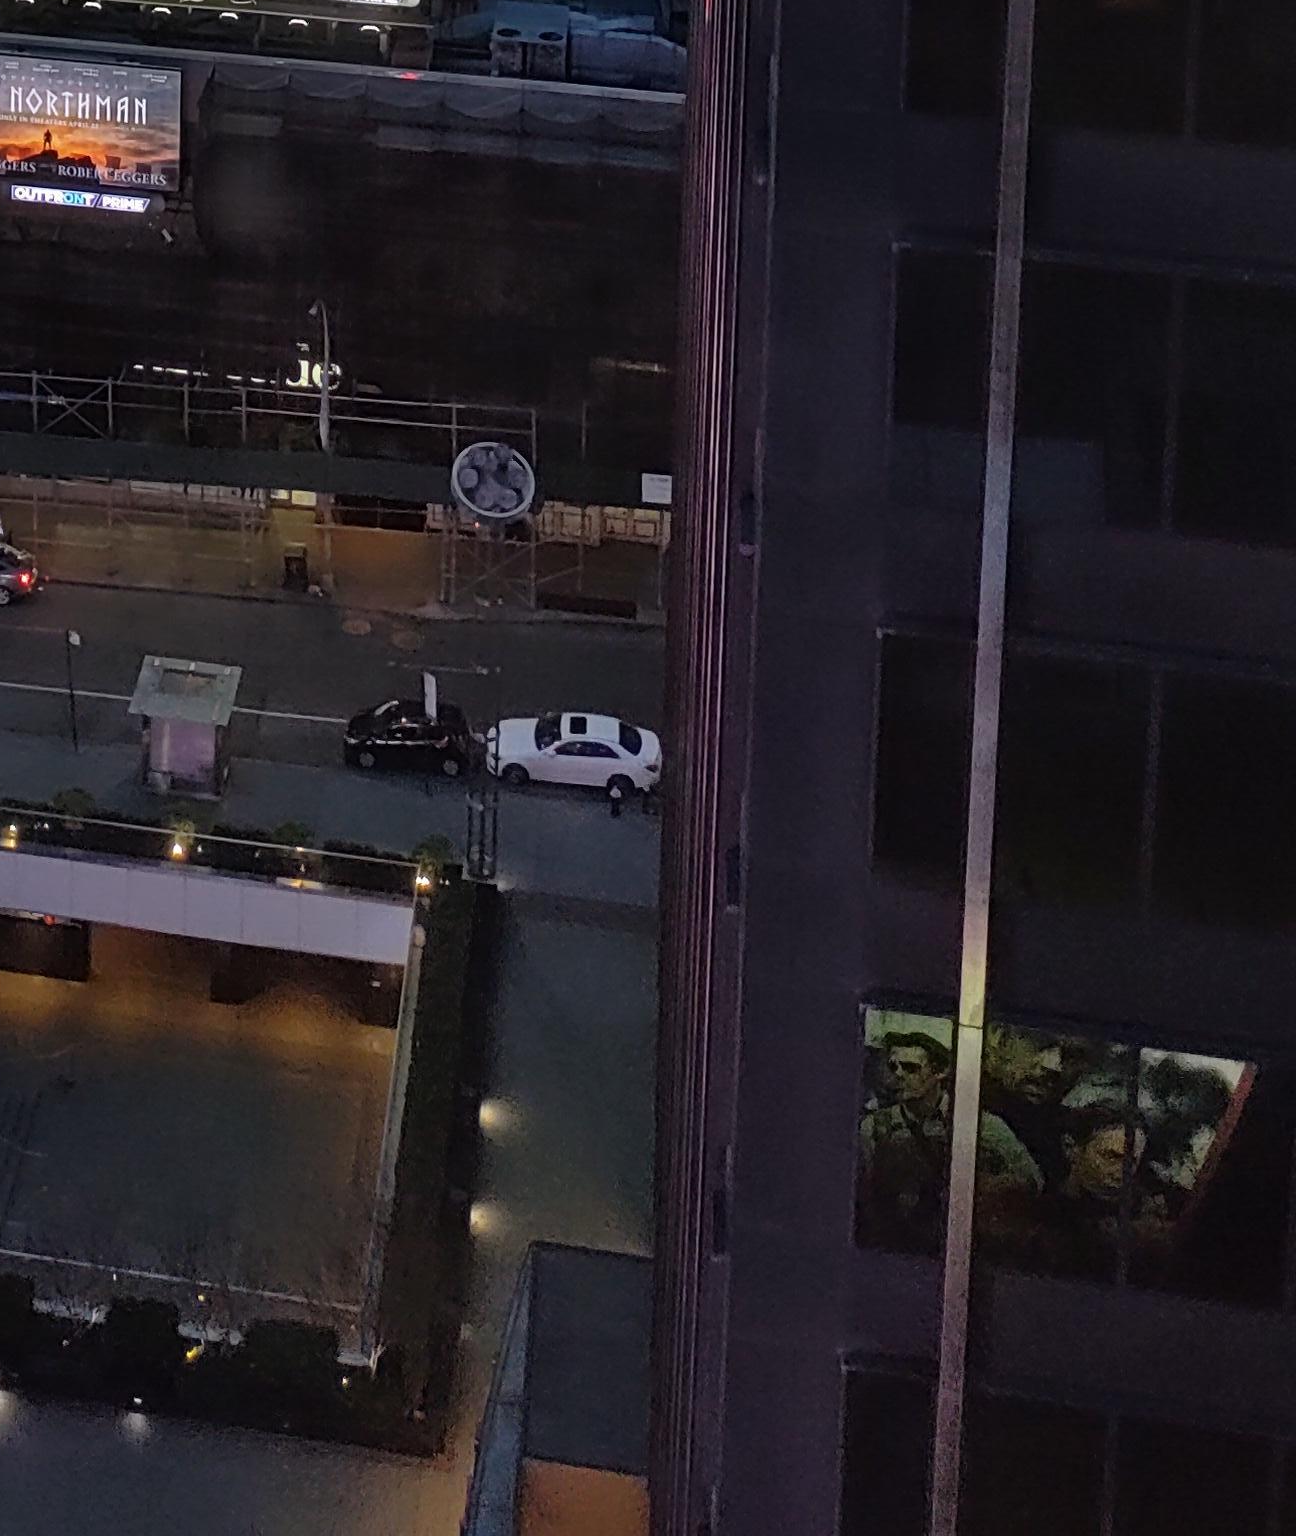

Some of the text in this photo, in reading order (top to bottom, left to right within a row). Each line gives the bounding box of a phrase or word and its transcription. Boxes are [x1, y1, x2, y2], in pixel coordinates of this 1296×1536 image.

[9, 85, 148, 125] NORTHMAN
[29, 117, 67, 127] THEATERS
[68, 120, 90, 128] APRIL
[58, 164, 113, 181] ROBERT
[112, 169, 167, 186] EGGERS
[14, 187, 146, 211] OUTFRONT PRIME
